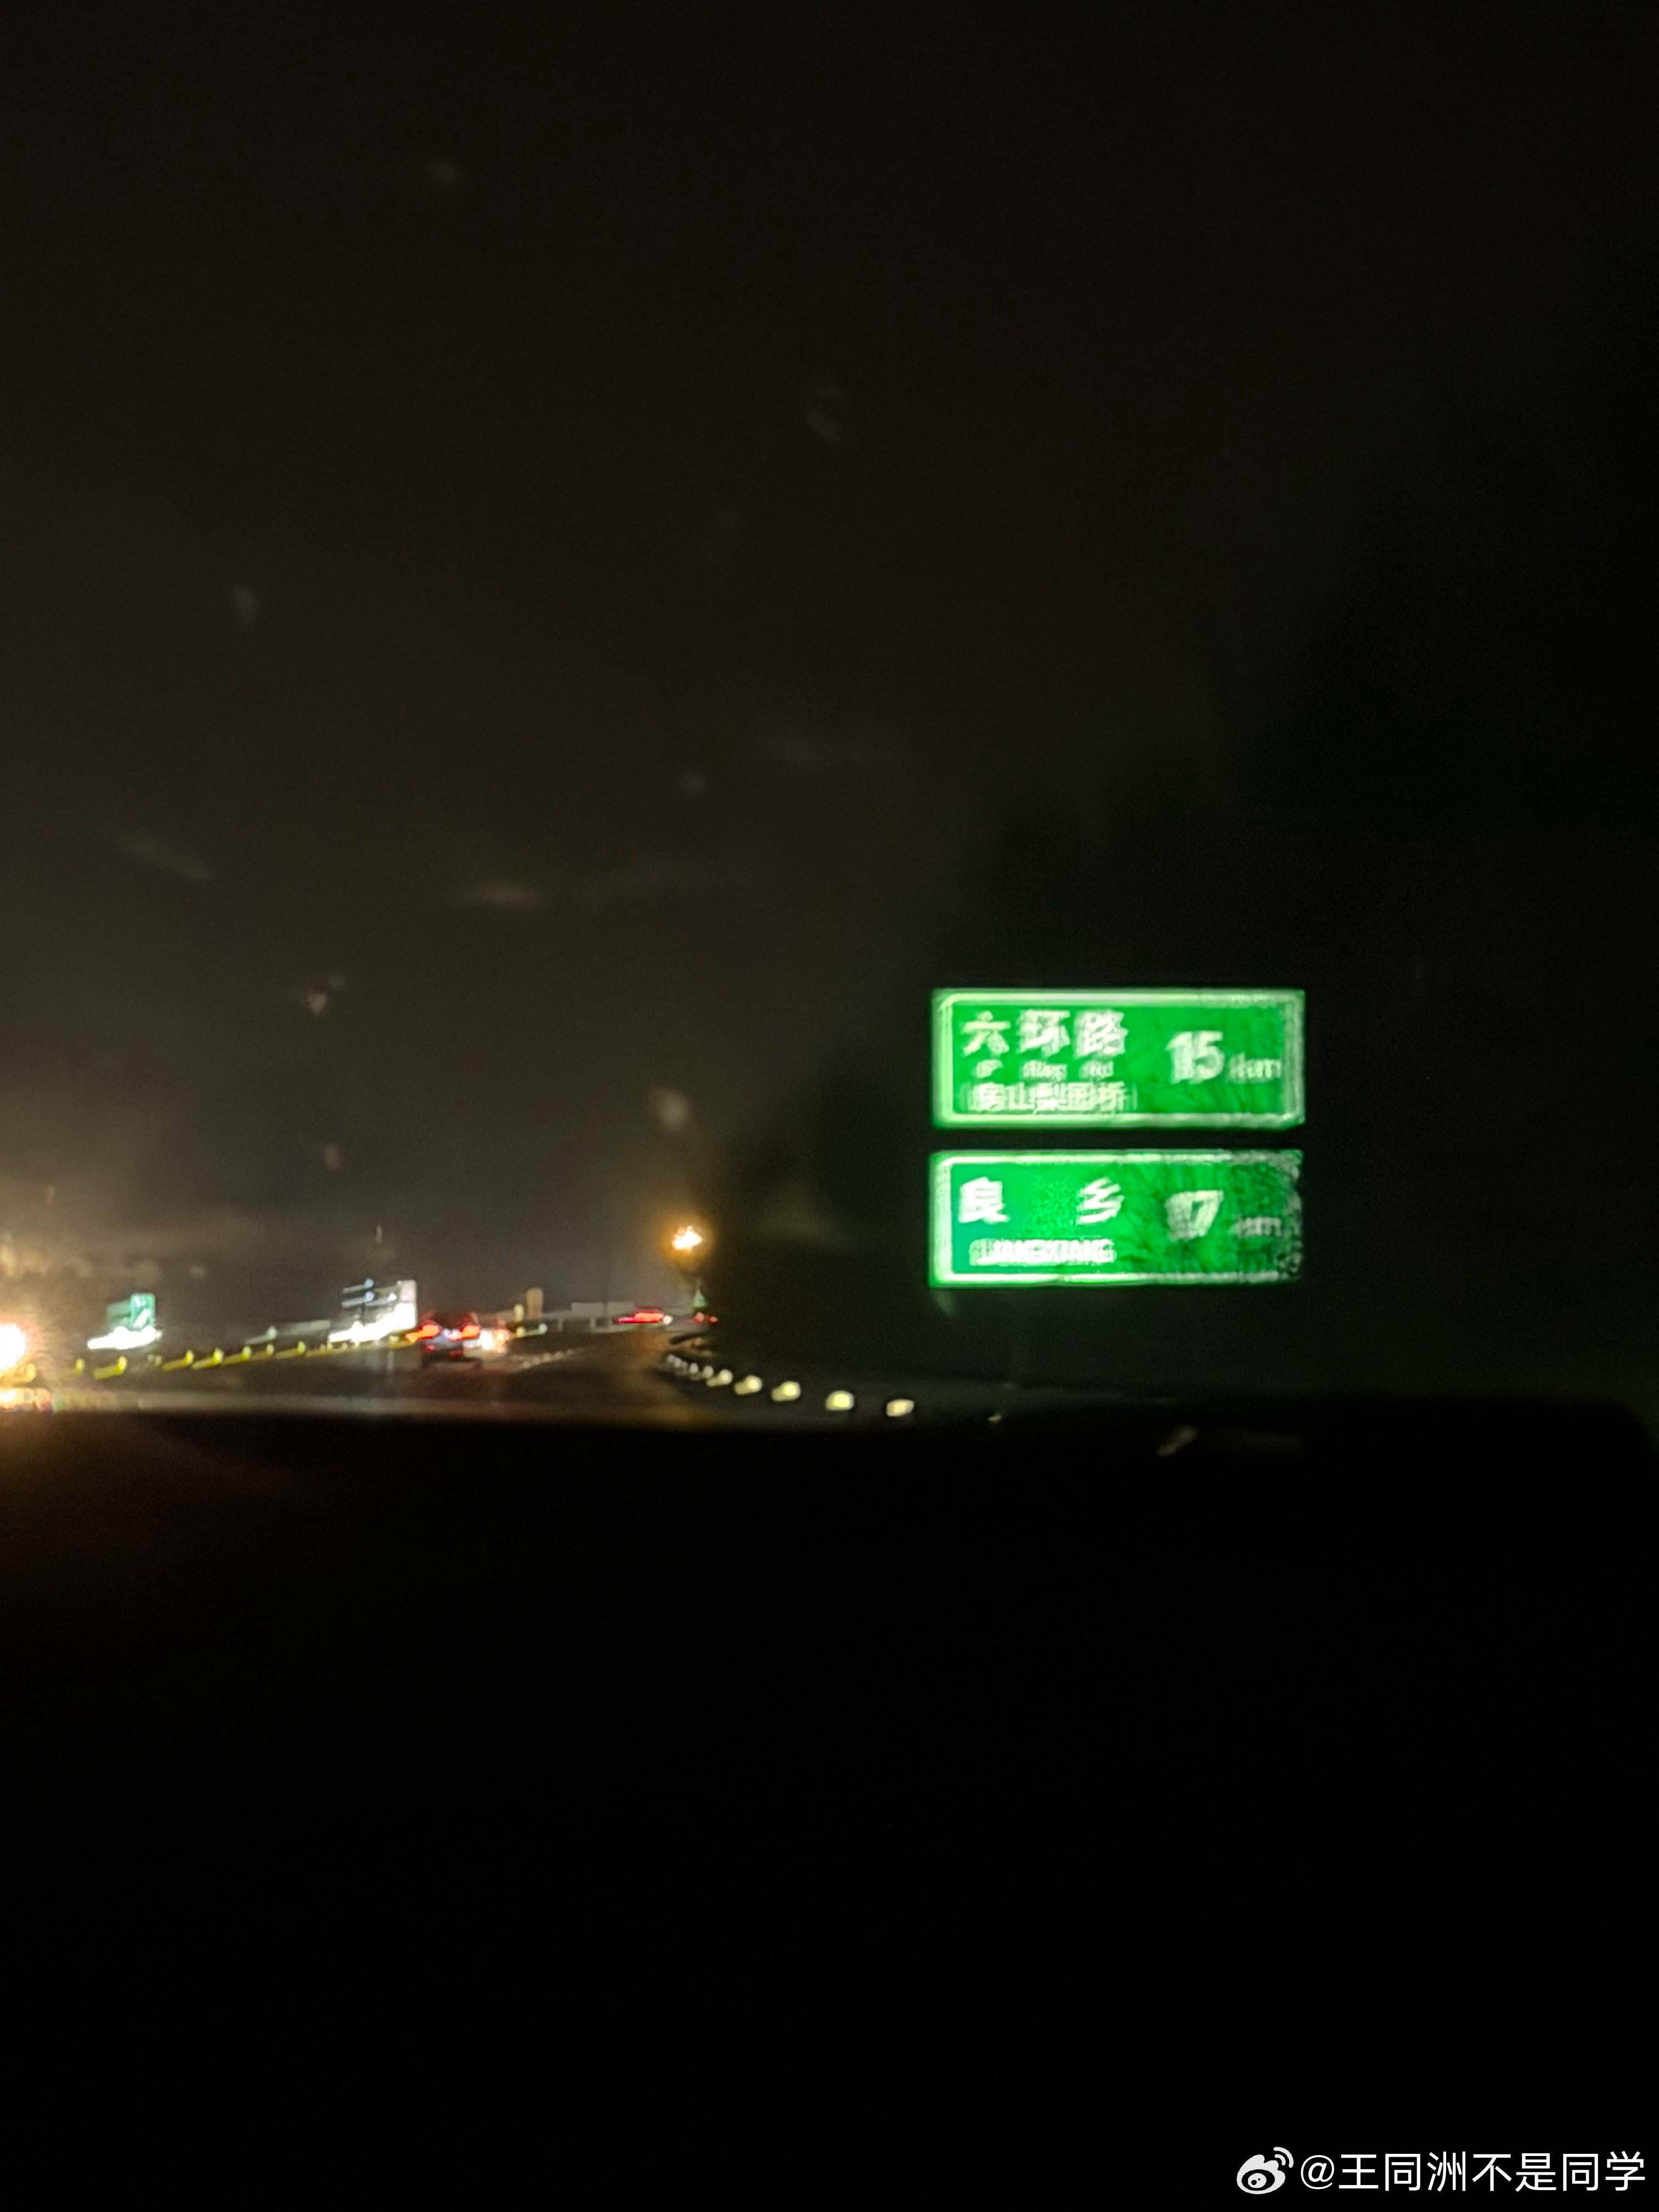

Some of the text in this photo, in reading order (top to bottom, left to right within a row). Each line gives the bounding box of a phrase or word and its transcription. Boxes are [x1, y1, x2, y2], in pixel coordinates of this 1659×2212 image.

[961, 1009, 1128, 1058] 六环路
[1166, 1029, 1224, 1084] 15
[1165, 1189, 1224, 1241] 17
